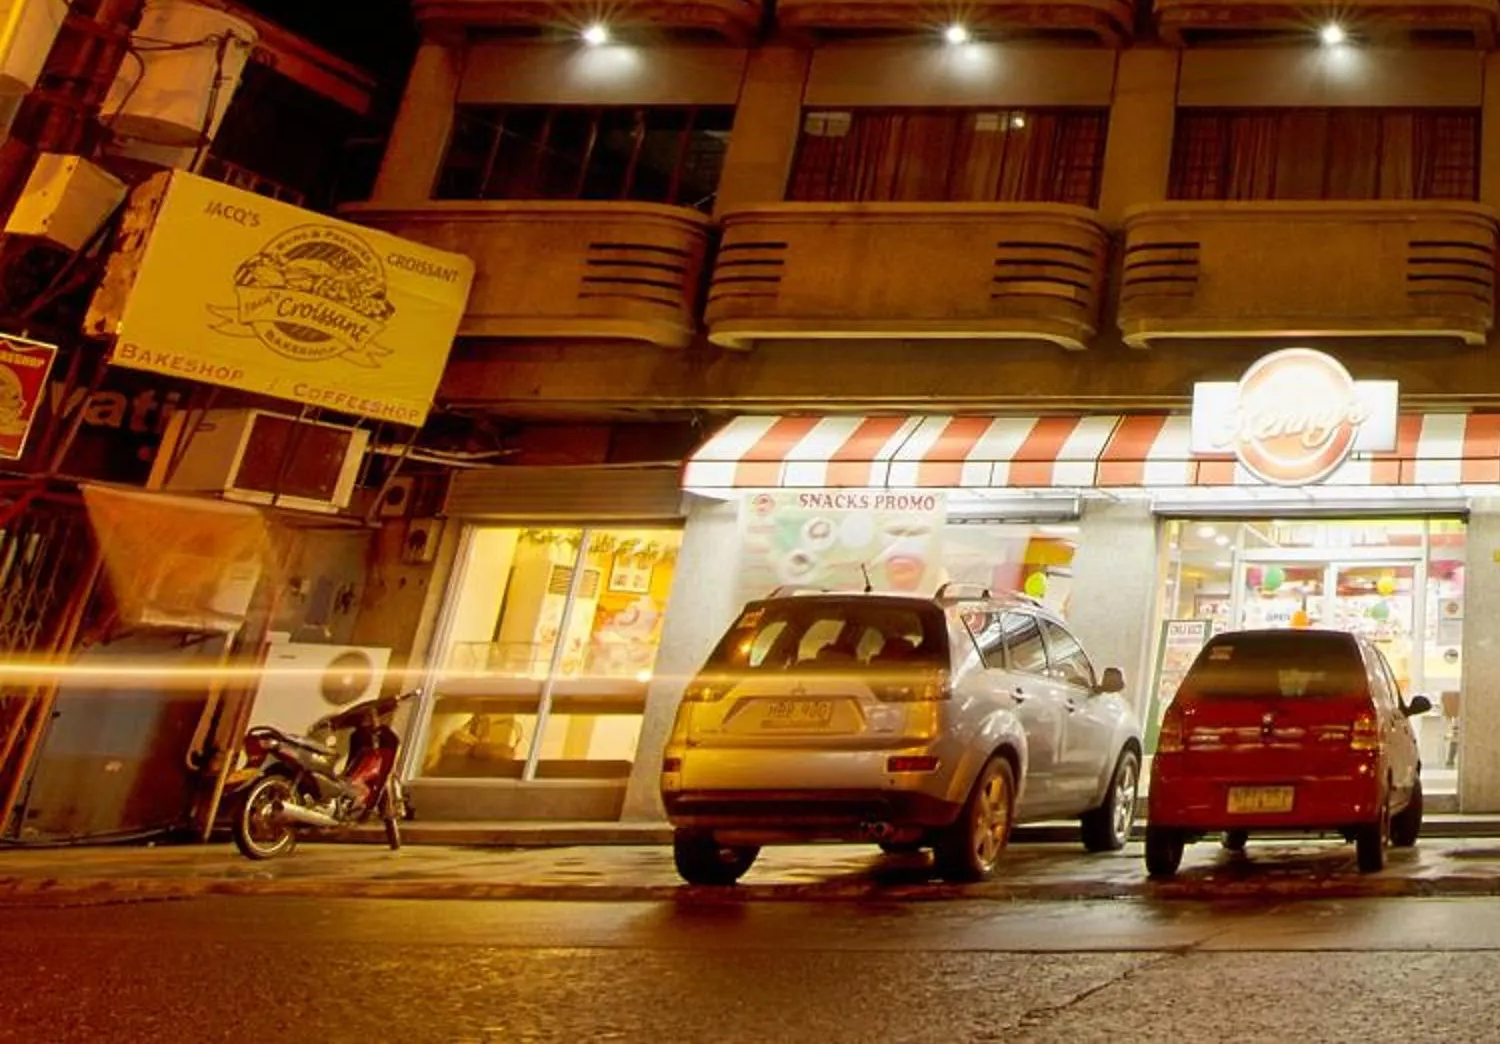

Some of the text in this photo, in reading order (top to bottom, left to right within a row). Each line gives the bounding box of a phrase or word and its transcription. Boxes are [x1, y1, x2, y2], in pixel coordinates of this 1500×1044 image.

[204, 200, 261, 229] JACQ'S
[386, 253, 460, 283] CROISSANT
[119, 342, 245, 381] BAKESHOP
[292, 383, 421, 421] COFFEESHOP
[799, 493, 936, 511] SNACKS PROMO
